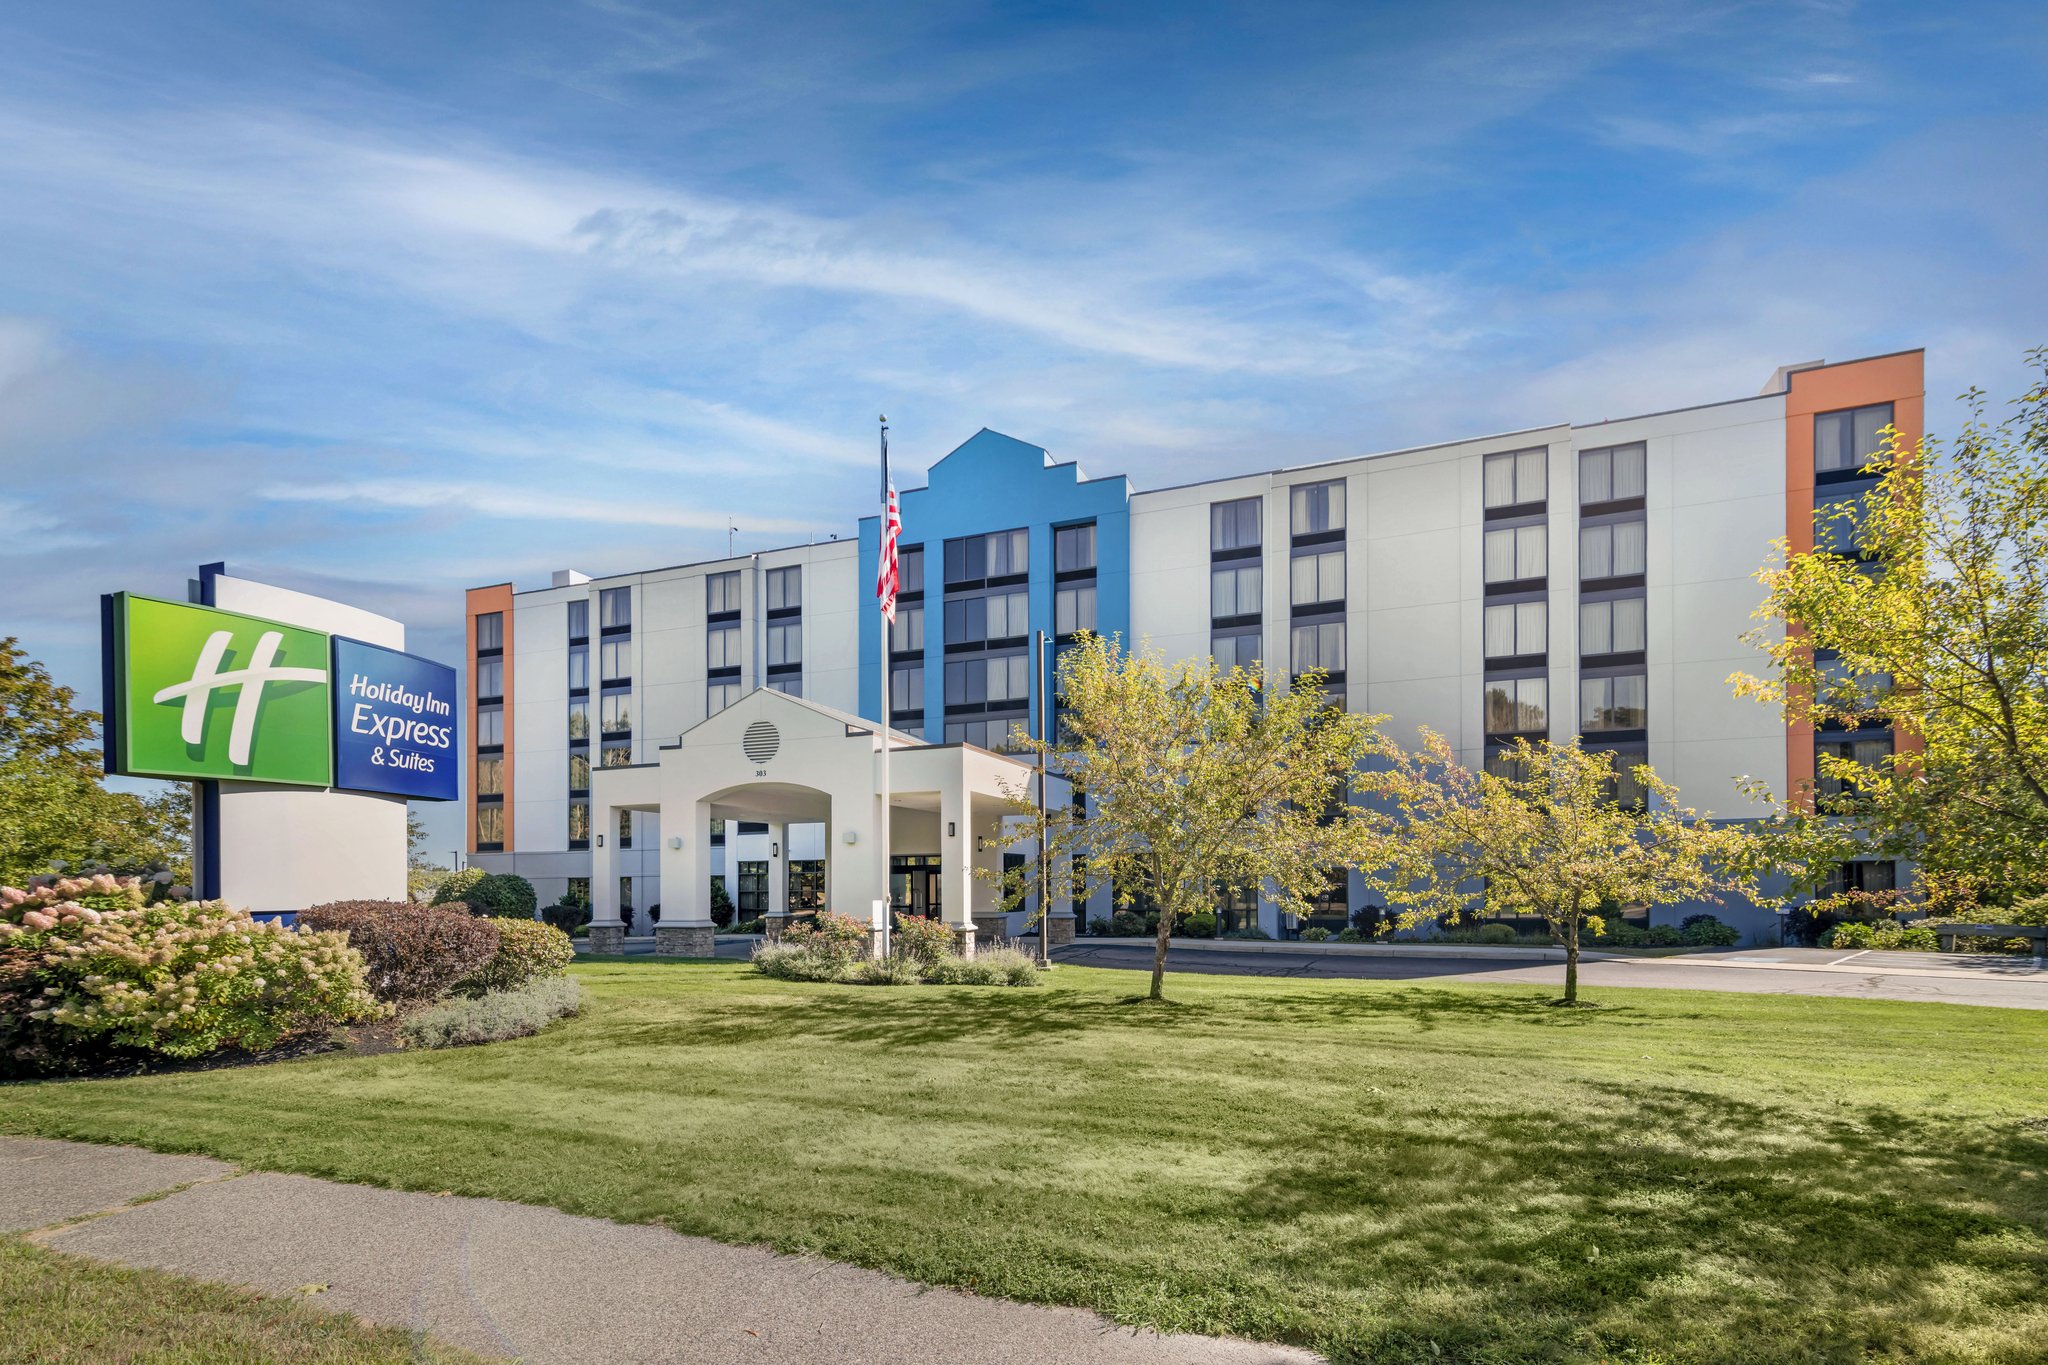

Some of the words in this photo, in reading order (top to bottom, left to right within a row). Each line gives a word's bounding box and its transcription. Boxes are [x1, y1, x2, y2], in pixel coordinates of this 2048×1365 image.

[349, 673, 425, 714] Holiday
[425, 691, 450, 716] Inn
[350, 702, 451, 749] Express
[371, 746, 385, 766] &
[388, 748, 435, 773] Suites
